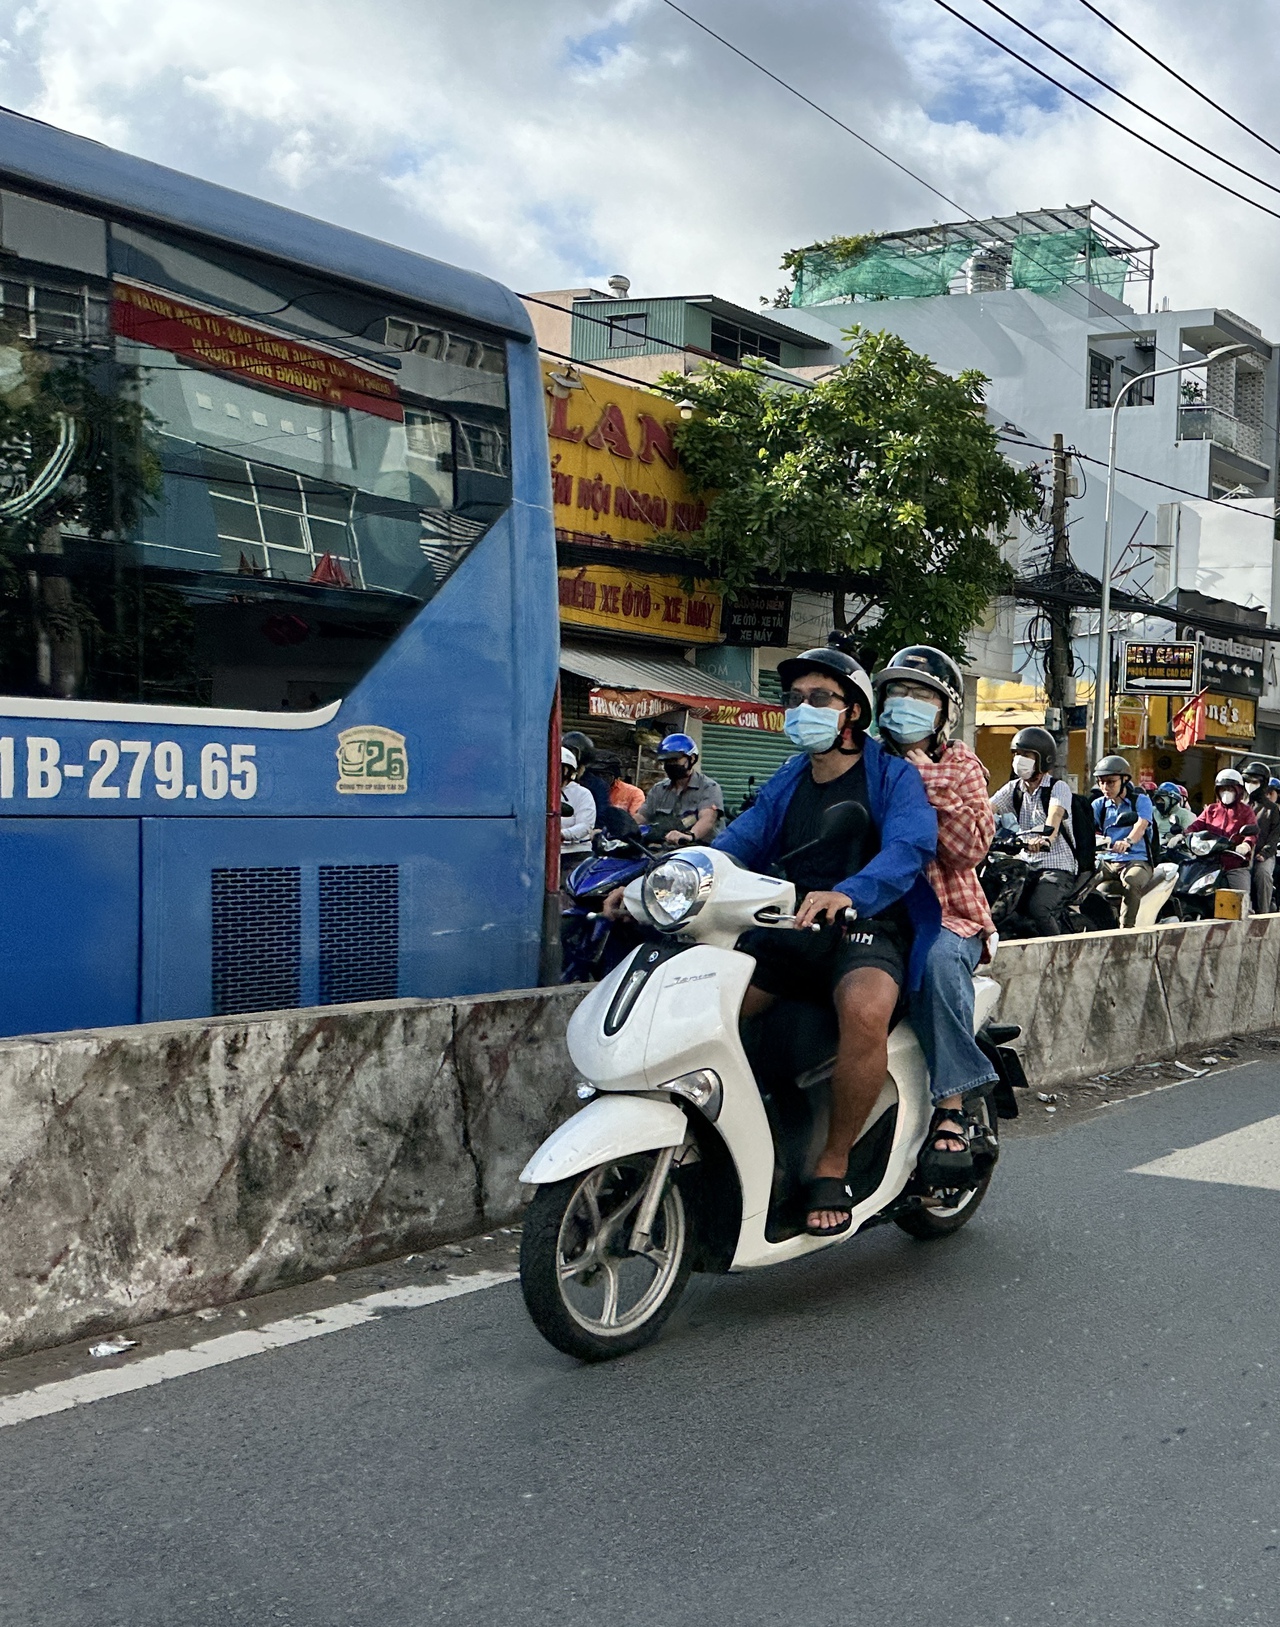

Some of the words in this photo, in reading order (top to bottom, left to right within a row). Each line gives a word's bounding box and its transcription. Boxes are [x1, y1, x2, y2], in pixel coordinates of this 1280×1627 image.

[601, 584, 621, 614] XE
[662, 594, 683, 624] XE
[732, 613, 742, 625] XE
[761, 615, 771, 627] XE
[740, 629, 752, 641] XE
[753, 627, 774, 642] MÁY
[0, 736, 258, 800] 1B-279.65
[366, 740, 405, 781] 26
